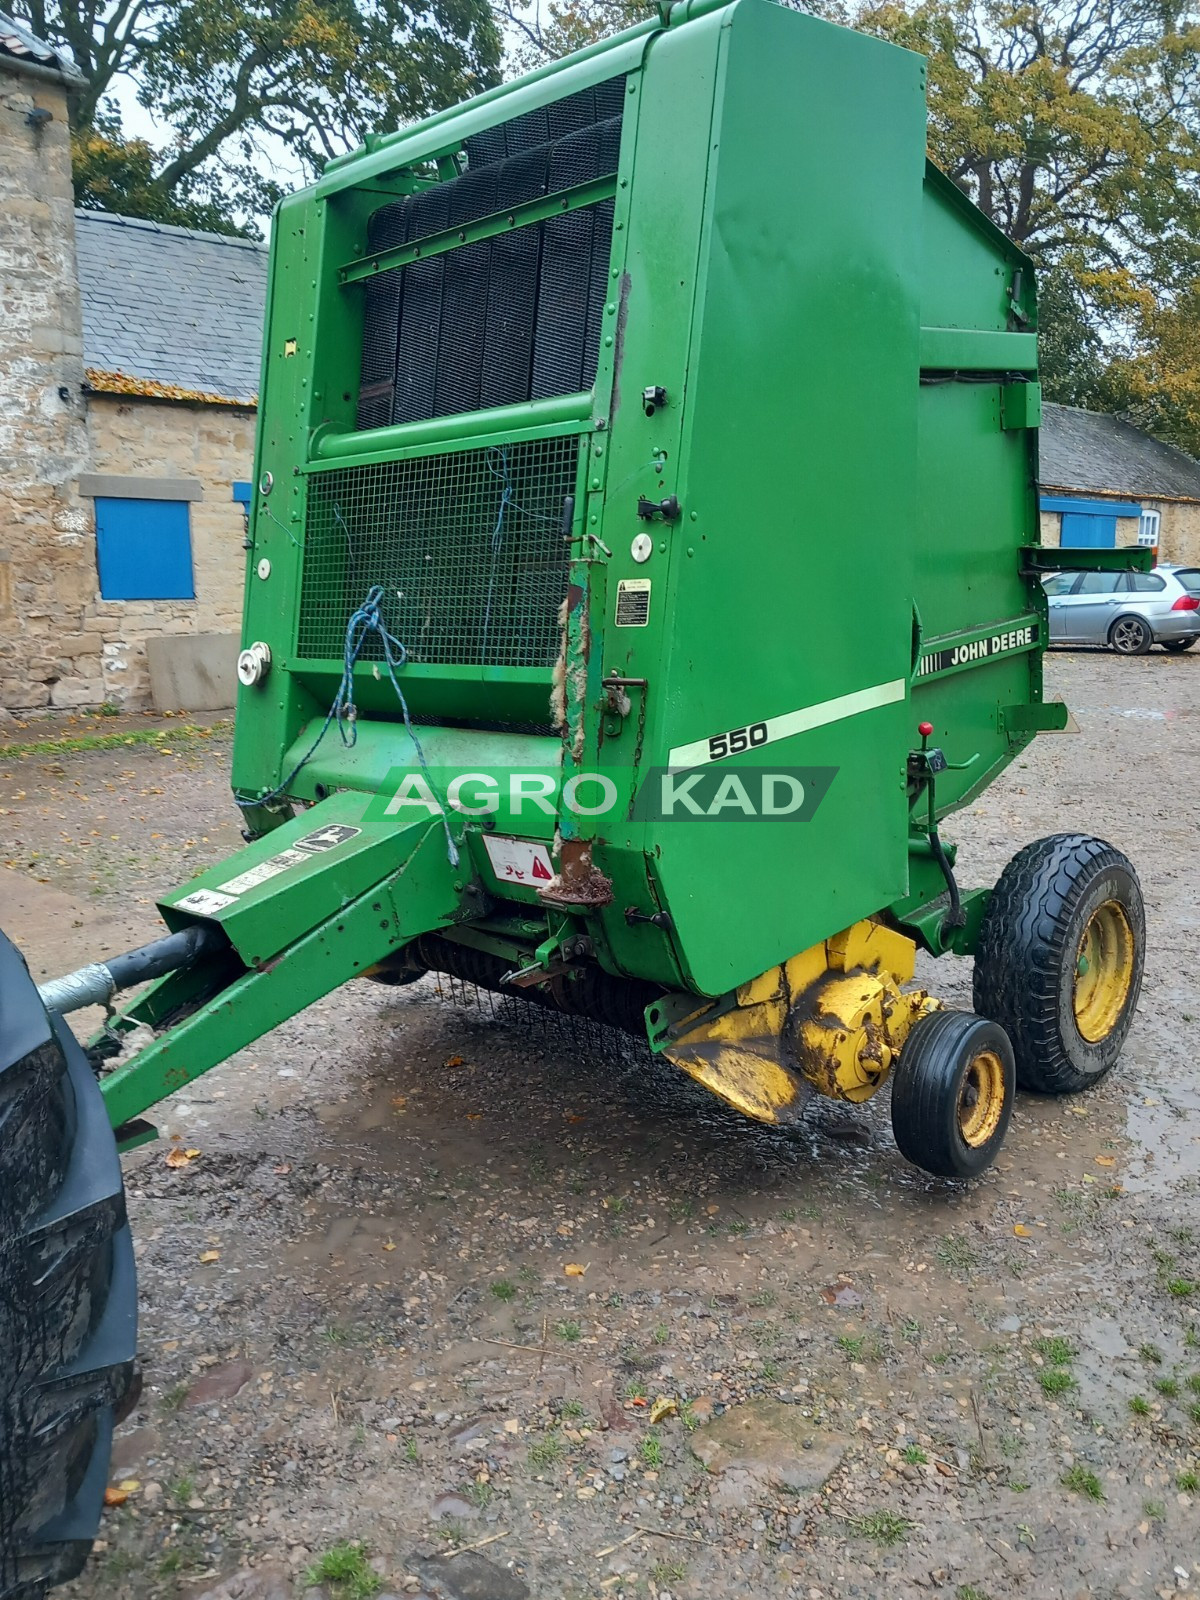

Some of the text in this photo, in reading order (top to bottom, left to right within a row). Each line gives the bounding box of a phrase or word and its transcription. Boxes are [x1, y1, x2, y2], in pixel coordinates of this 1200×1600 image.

[951, 627, 1032, 665] JOHN DEERE
[709, 723, 768, 760] 550
